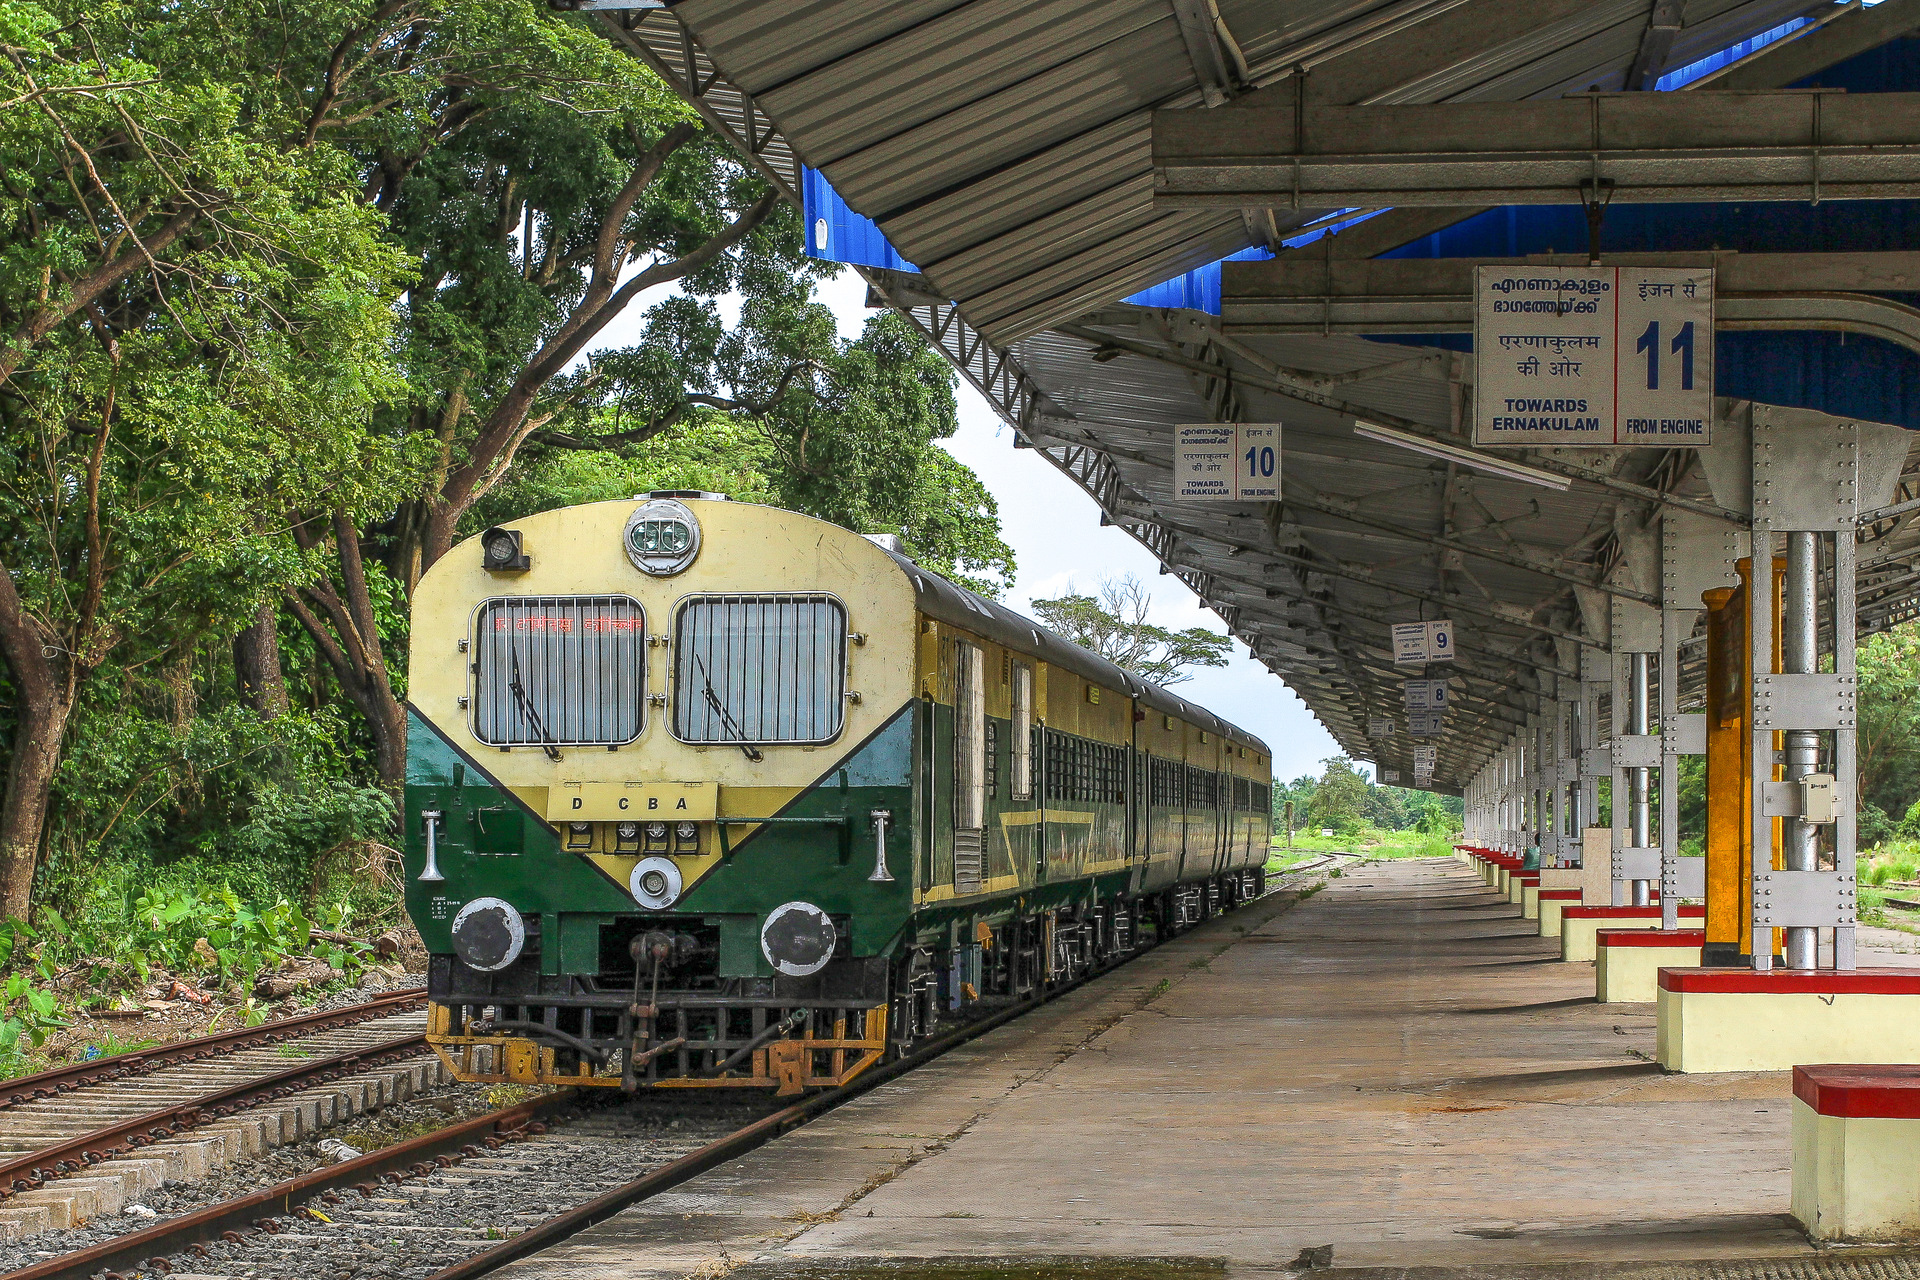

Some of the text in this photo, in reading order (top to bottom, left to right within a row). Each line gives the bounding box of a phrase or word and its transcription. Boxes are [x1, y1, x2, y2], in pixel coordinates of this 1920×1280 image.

[1491, 278, 1610, 295] എറണാകുളം
[1638, 279, 1697, 302] इंजन से
[1499, 335, 1601, 354] एरणाकुलम
[1636, 320, 1694, 391] 11
[1517, 356, 1582, 377] की ओर
[1505, 398, 1588, 413] TOWARDS
[1492, 417, 1599, 431] ERNAKULAM
[1626, 419, 1703, 435] FROM ENGINE
[1246, 428, 1273, 438] इंजन से
[1192, 462, 1221, 472] की ओर
[1245, 446, 1275, 477] 10
[1181, 488, 1229, 496] ERNAKULAM
[1436, 632, 1448, 649] 9
[1435, 688, 1444, 701] 8
[1387, 724, 1393, 732] 6
[1432, 719, 1439, 729] 7
[572, 796, 687, 810] D C B A
